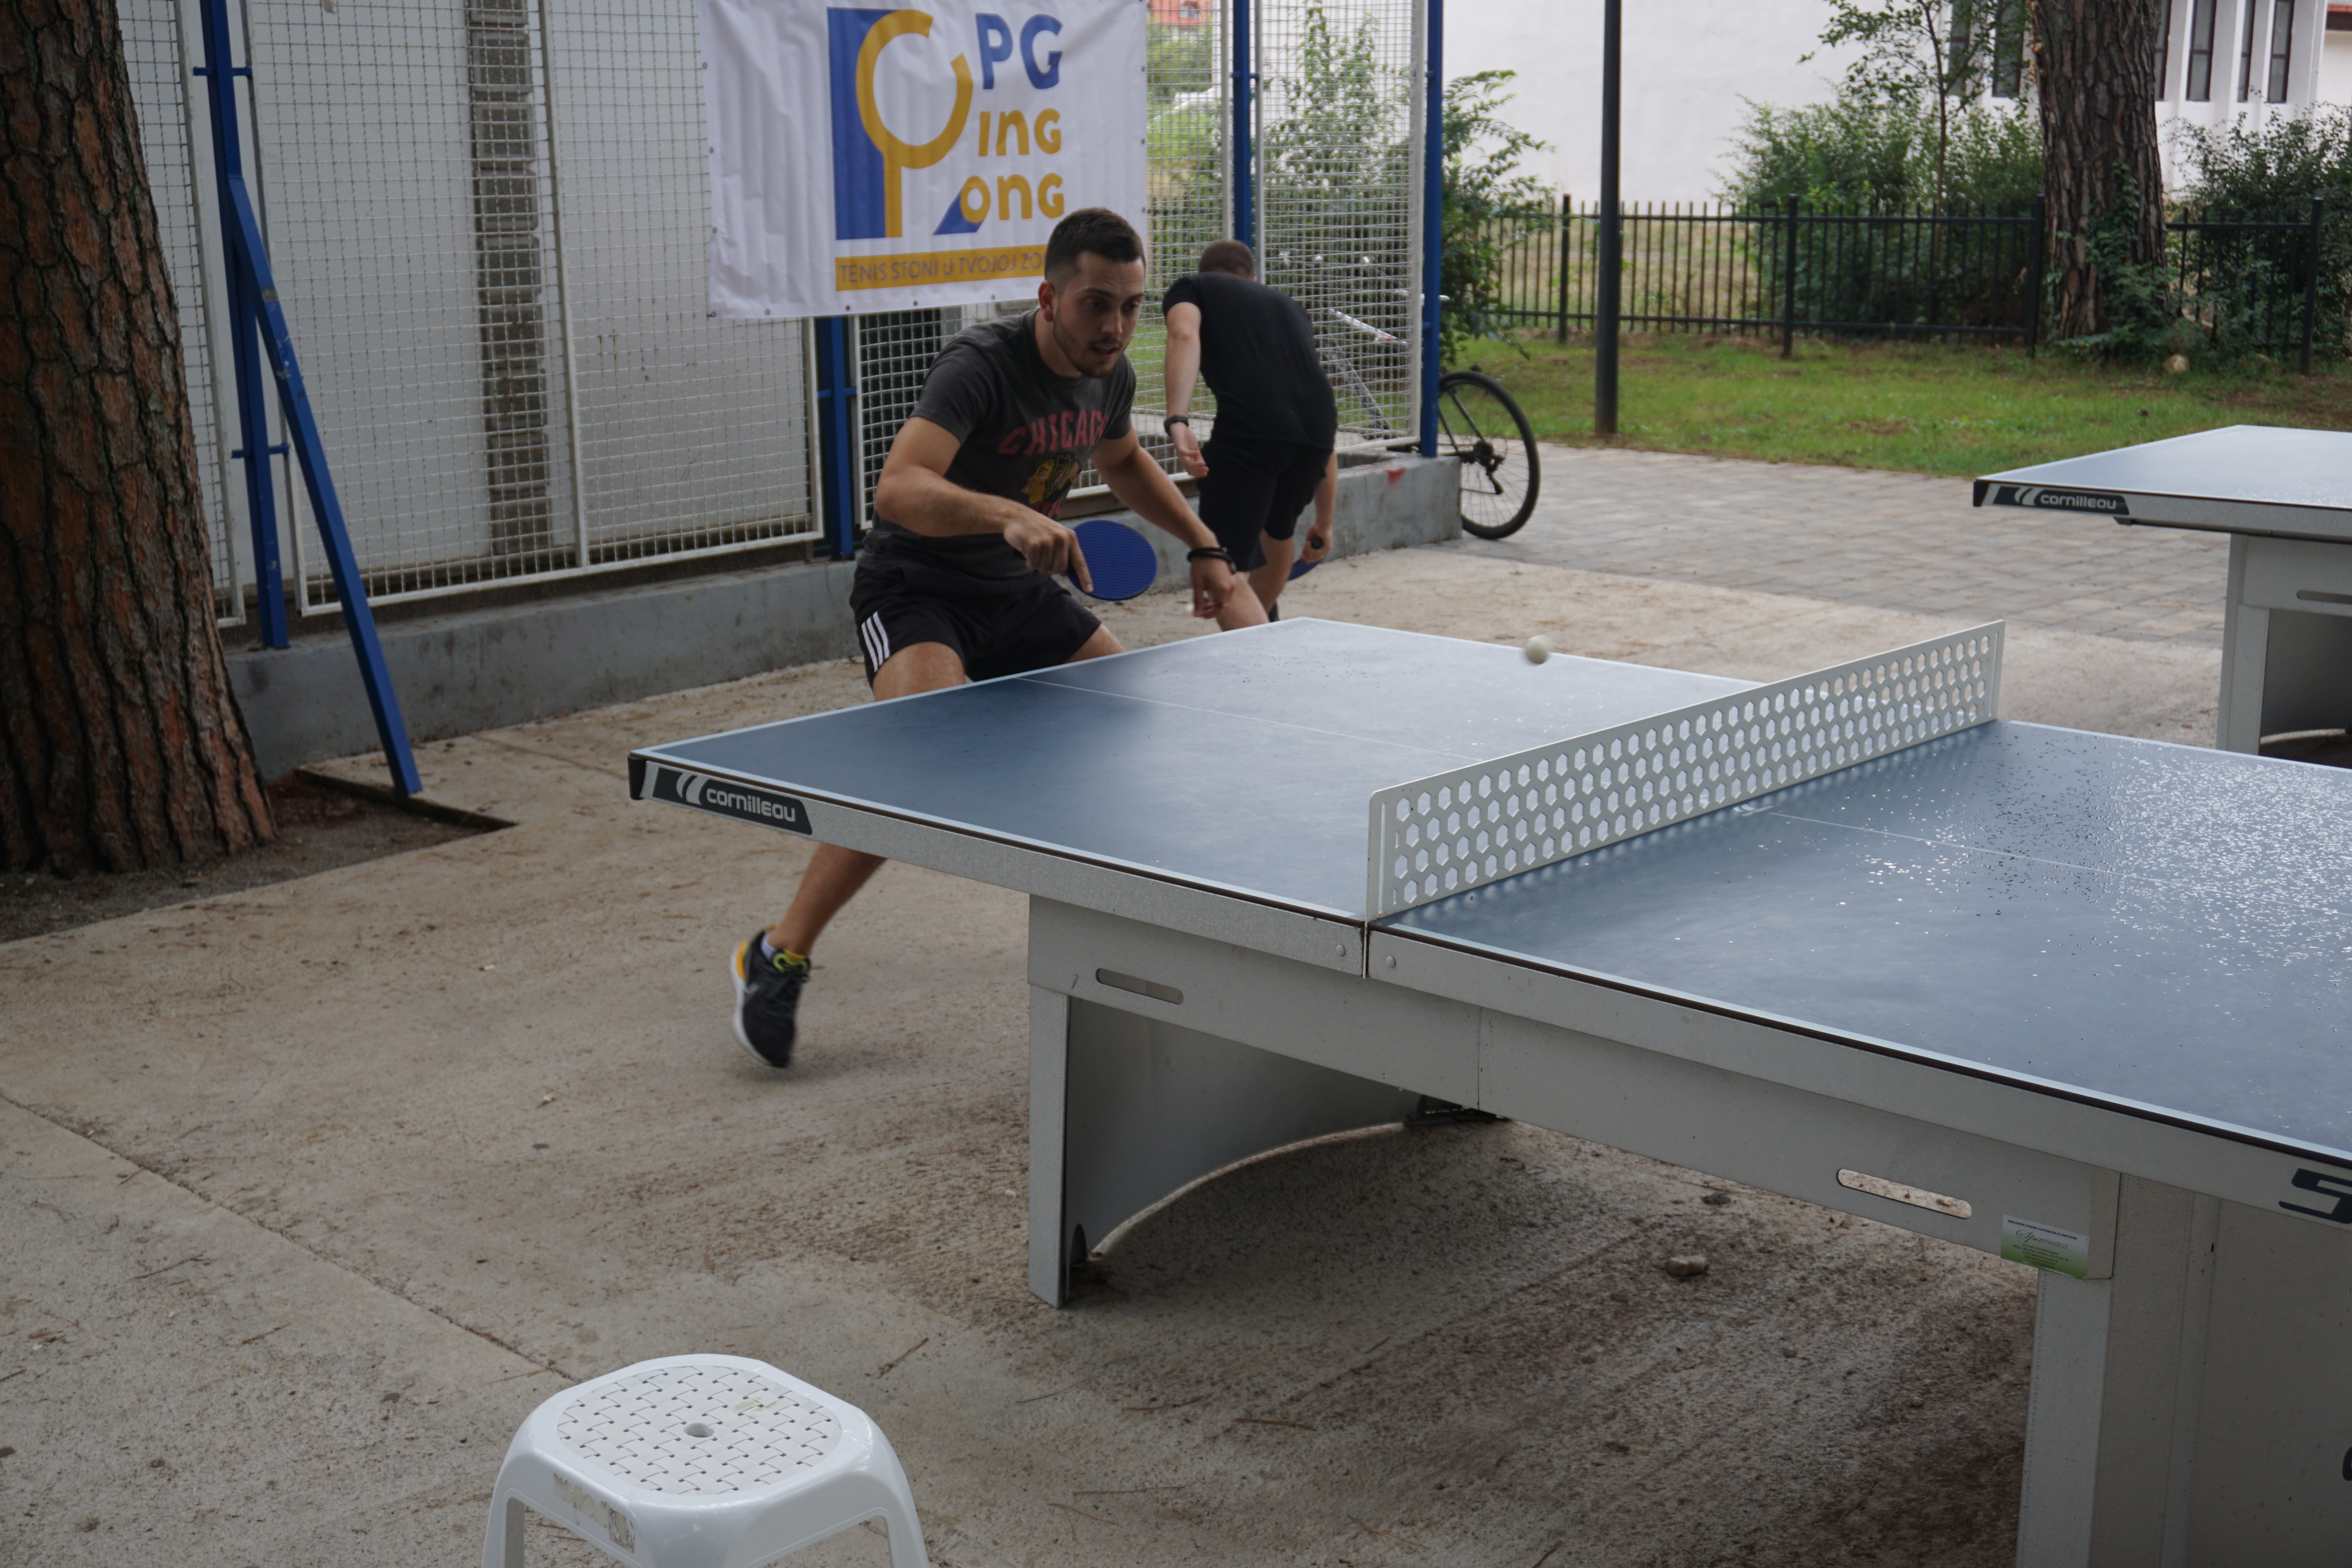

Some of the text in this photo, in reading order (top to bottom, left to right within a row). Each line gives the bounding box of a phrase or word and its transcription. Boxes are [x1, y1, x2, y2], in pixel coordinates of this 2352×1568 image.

[975, 13, 1063, 89] PG
[840, 252, 1046, 282] TENIS STONI U TVOJOJ ZO
[2040, 494, 2117, 509] cornilleau
[706, 788, 796, 822] cornilleau
